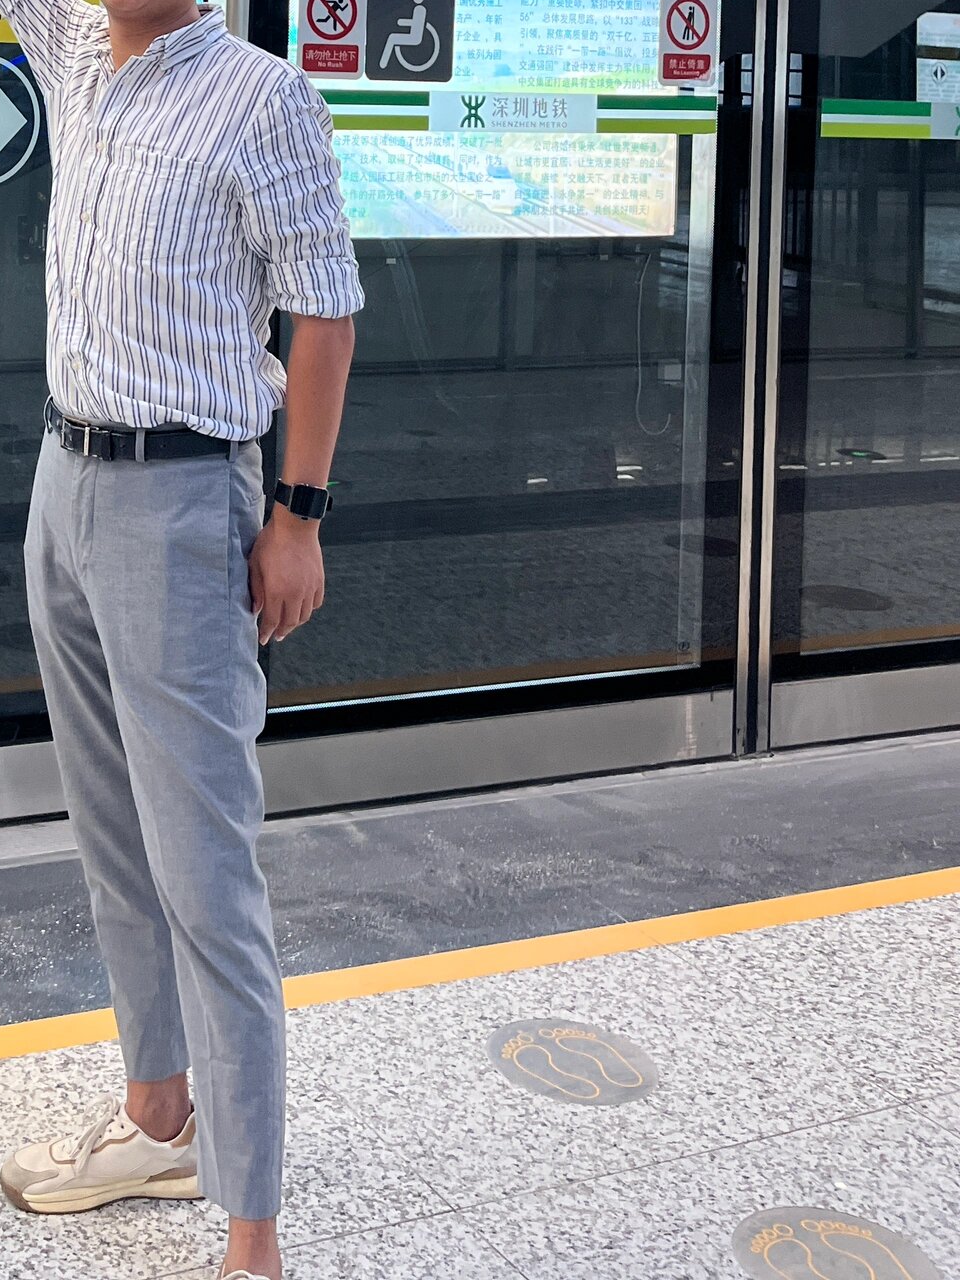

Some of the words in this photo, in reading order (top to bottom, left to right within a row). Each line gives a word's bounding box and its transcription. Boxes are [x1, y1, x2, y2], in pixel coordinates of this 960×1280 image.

[305, 50, 356, 61] 请勿抢上抢下
[670, 59, 704, 69] 禁止倚靠
[492, 97, 568, 118] 深圳地铁
[491, 120, 536, 128] SHENZHEN
